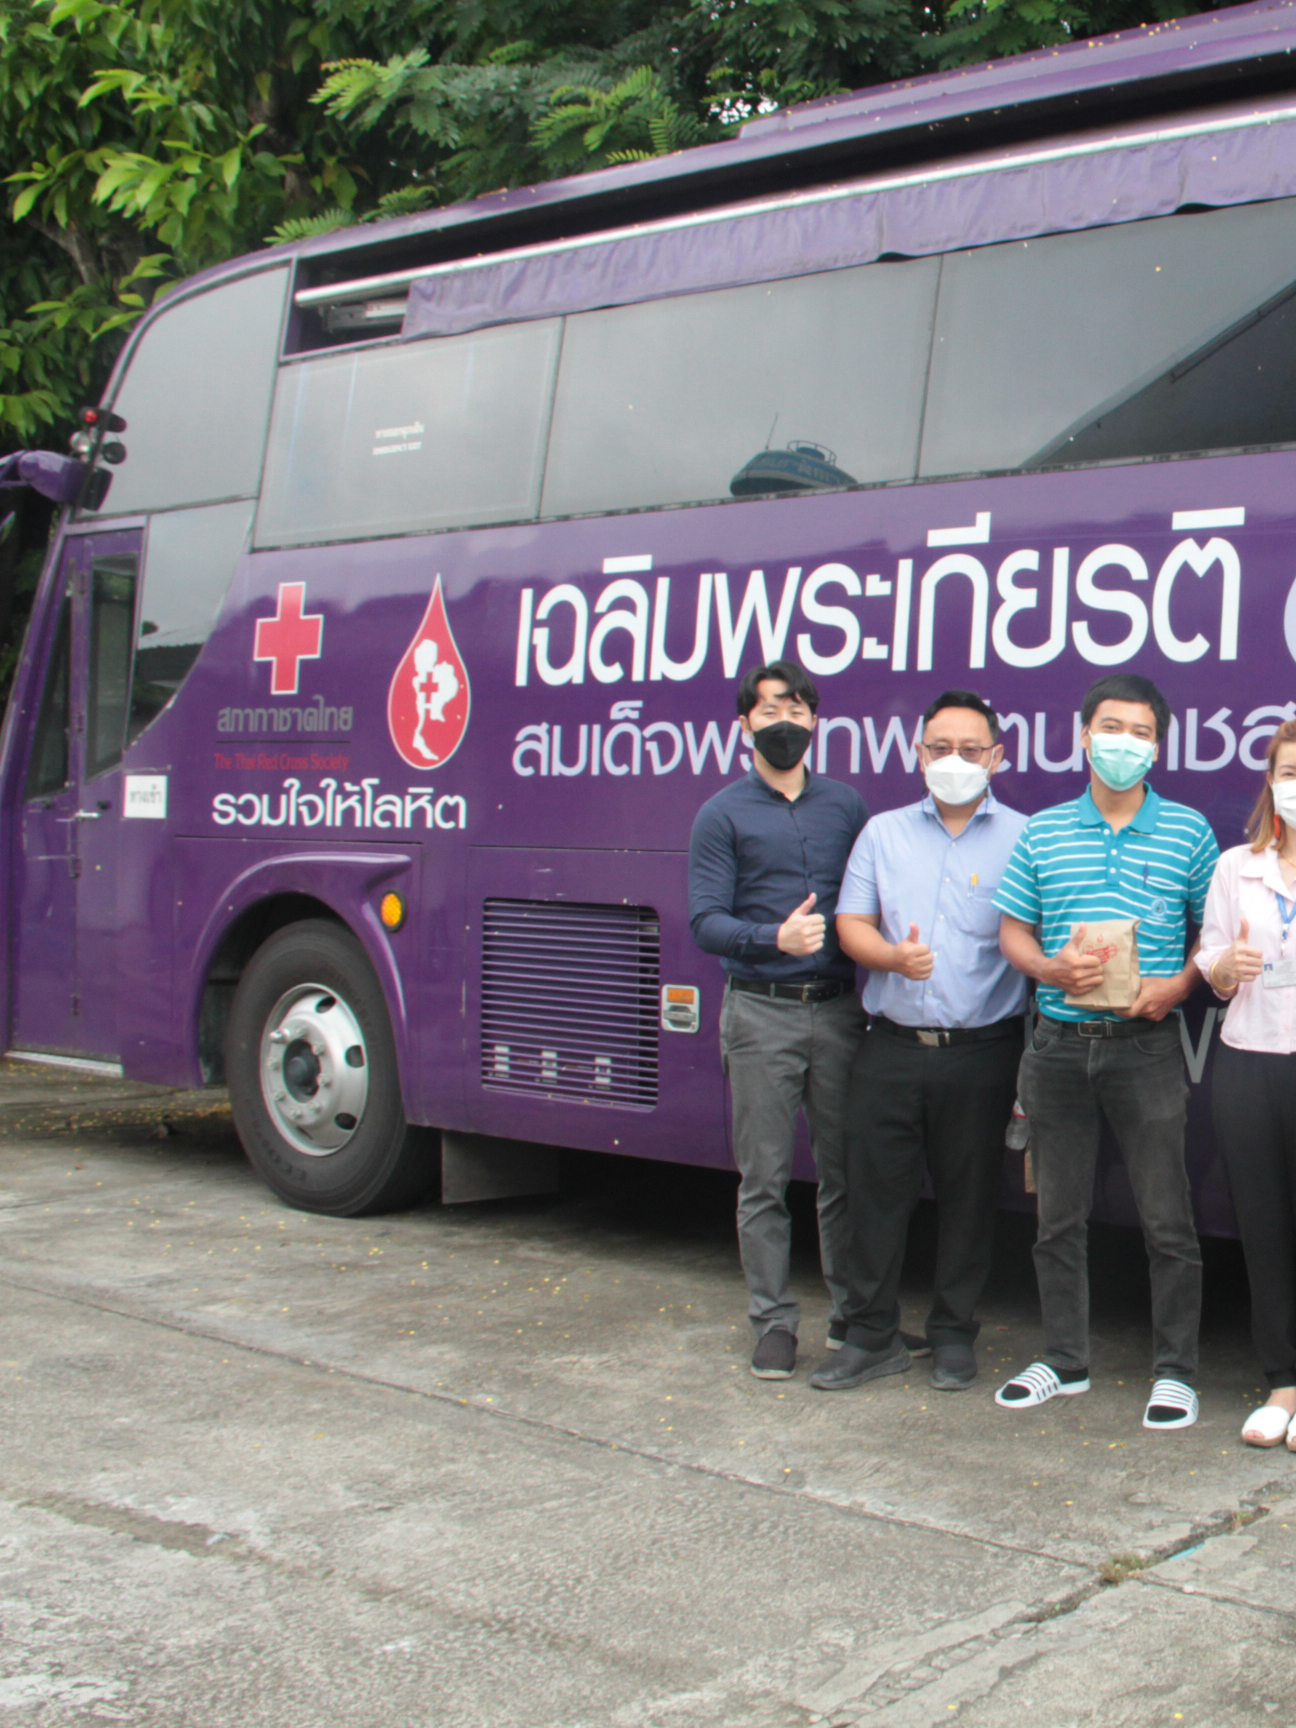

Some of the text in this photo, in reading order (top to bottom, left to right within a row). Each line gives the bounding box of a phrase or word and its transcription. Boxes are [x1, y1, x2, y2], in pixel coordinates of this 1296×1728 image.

[515, 507, 1245, 687] เฉลิมพระเกียรติ
[217, 694, 353, 732] สภากาชาดไทย
[214, 753, 350, 772] The Thai Red Cross Society
[212, 777, 467, 829] รวมใจให้โลหิต
